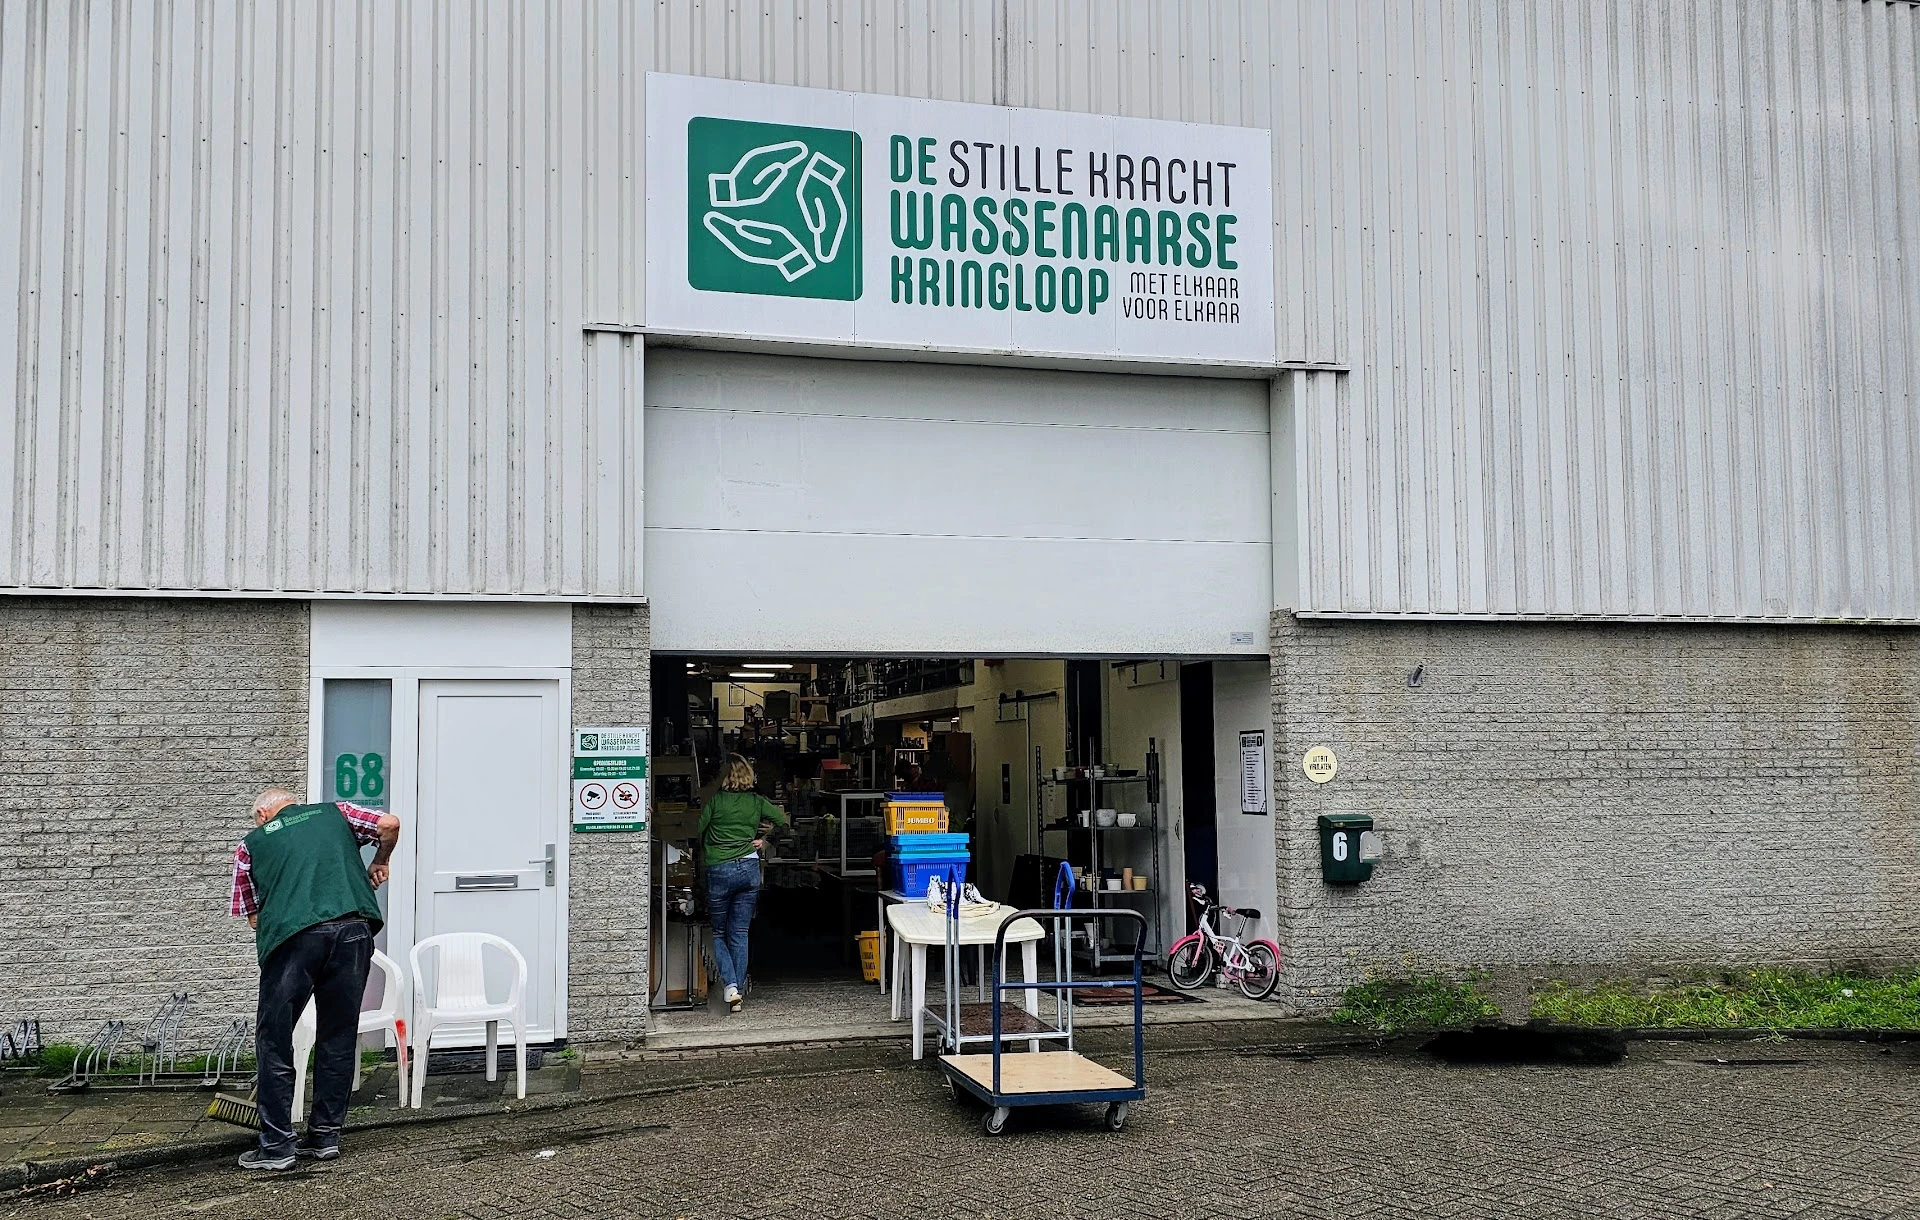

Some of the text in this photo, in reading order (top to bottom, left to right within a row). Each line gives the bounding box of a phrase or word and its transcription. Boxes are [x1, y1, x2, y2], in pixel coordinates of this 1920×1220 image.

[890, 134, 1237, 207] DE STILLE KRACHT
[890, 189, 1239, 270] WASSENAARSE
[891, 255, 1109, 315] KRINGLOOP
[1130, 271, 1239, 299] MET ELKAAR
[1122, 296, 1240, 324] VOOR ELKAAR
[336, 752, 384, 798] 68
[1312, 755, 1328, 763] UITRIT
[1332, 831, 1348, 862] 6
